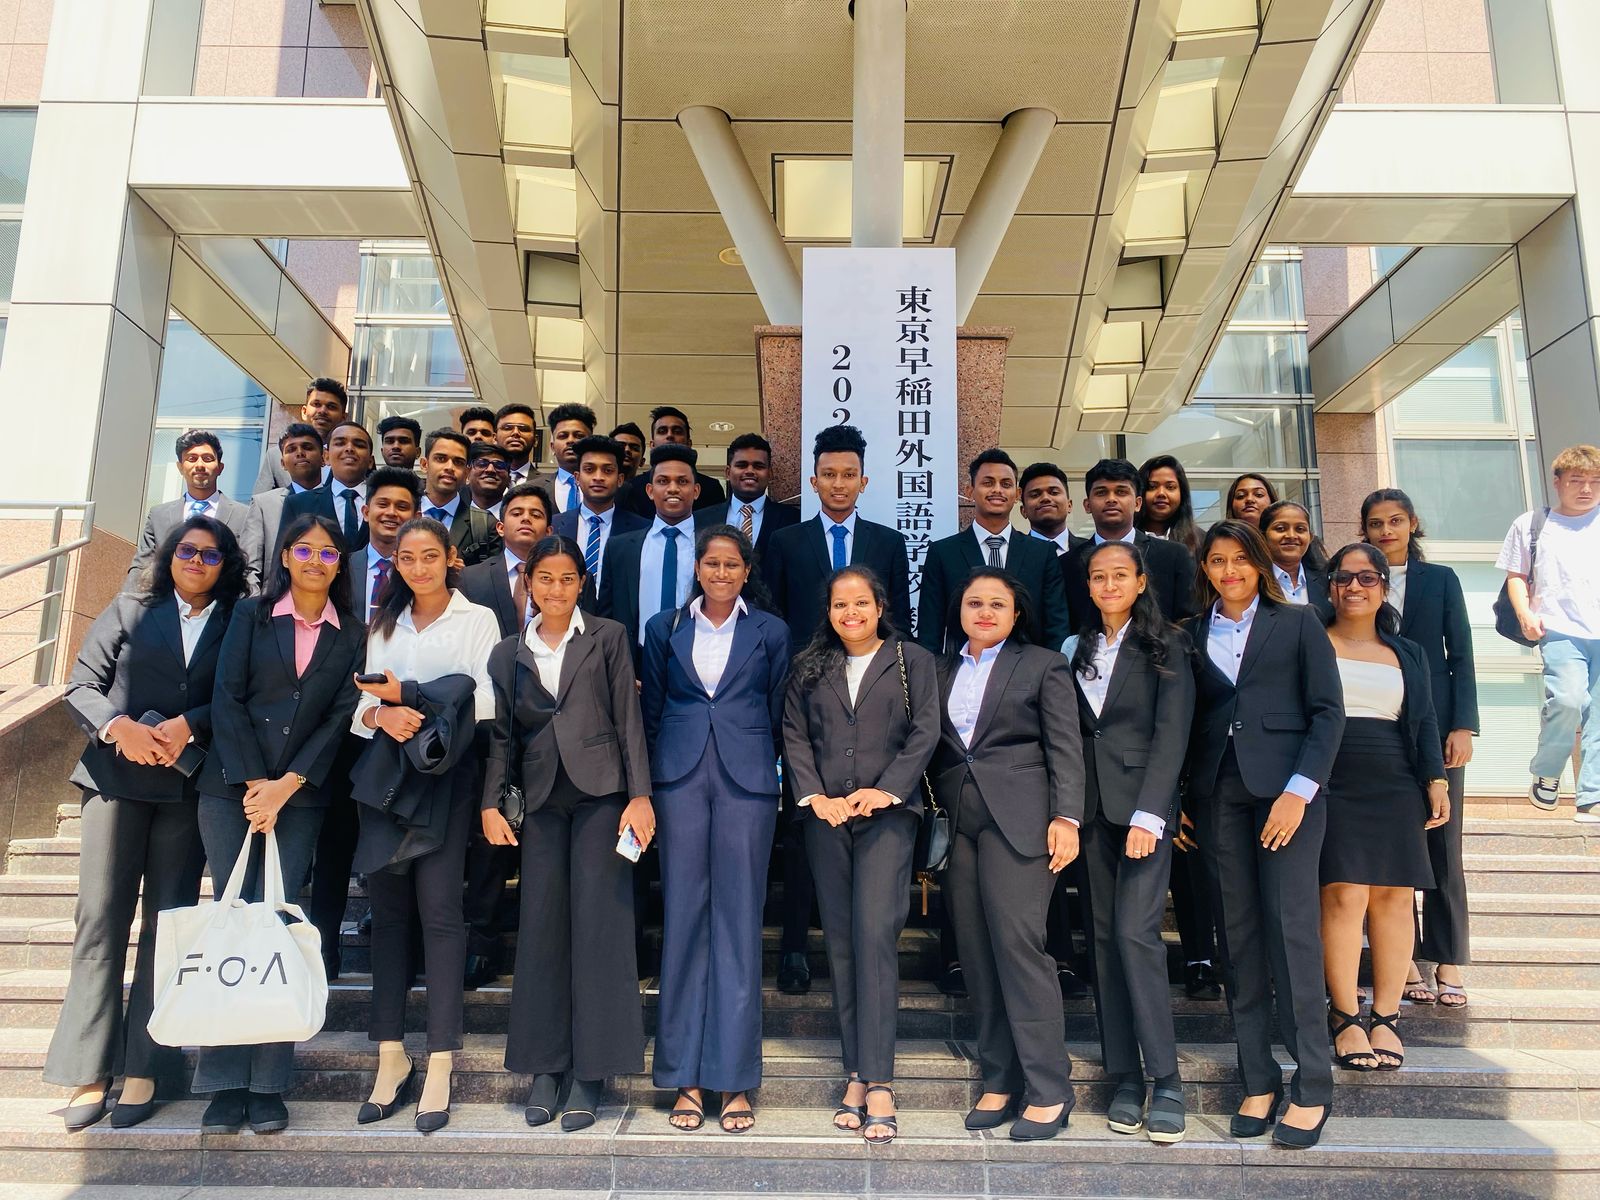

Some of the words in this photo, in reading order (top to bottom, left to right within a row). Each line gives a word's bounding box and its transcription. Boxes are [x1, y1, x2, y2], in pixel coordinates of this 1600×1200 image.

[896, 286, 934, 638] 東京早稲田外国語学
